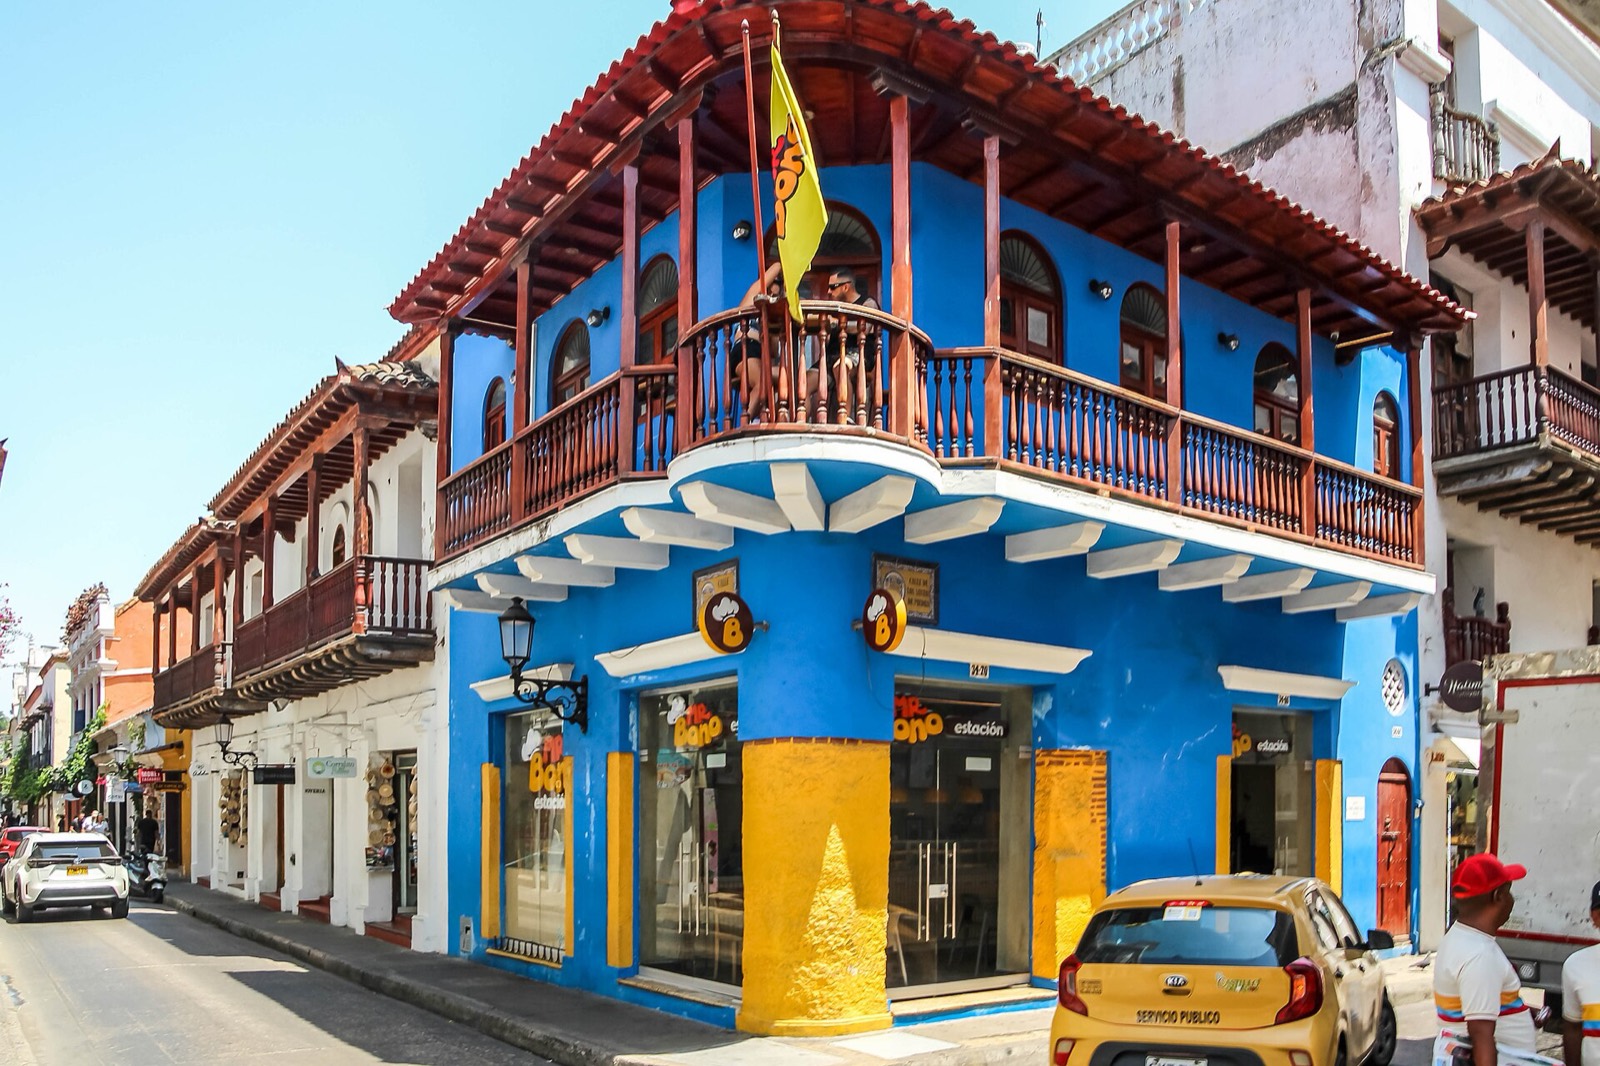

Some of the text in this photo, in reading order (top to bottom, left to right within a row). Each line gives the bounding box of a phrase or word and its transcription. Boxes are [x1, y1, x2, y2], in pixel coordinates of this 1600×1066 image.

[722, 617, 744, 648] B
[875, 613, 891, 646] B
[674, 715, 722, 748] Bono
[893, 713, 943, 744] ono
[954, 720, 1004, 737] estación
[529, 751, 567, 792] Bon
[534, 794, 565, 809] estació
[1166, 976, 1186, 986] KIA
[1136, 1010, 1220, 1025] SERVICIO PUBLICO
